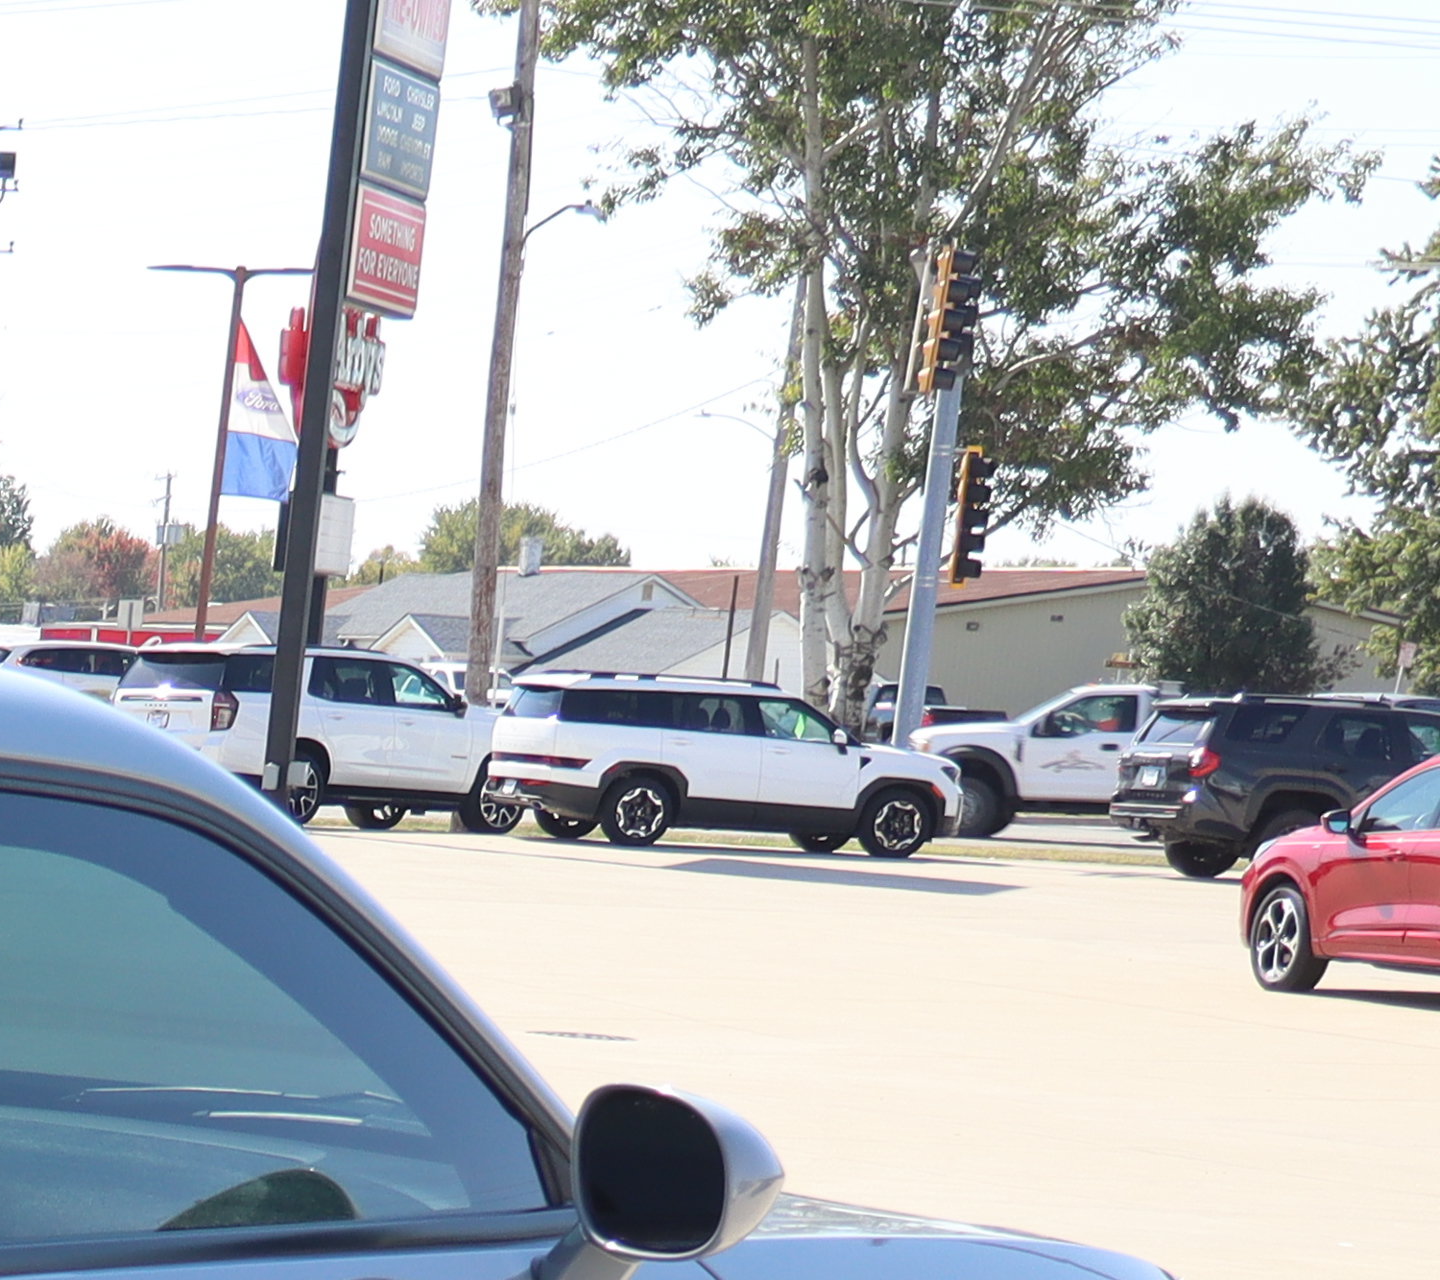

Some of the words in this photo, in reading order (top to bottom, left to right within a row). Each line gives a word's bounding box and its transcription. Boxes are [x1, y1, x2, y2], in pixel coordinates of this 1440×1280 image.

[369, 213, 416, 252] SOMETHING
[357, 247, 376, 275] FOR
[377, 253, 418, 290] EVERYONE
